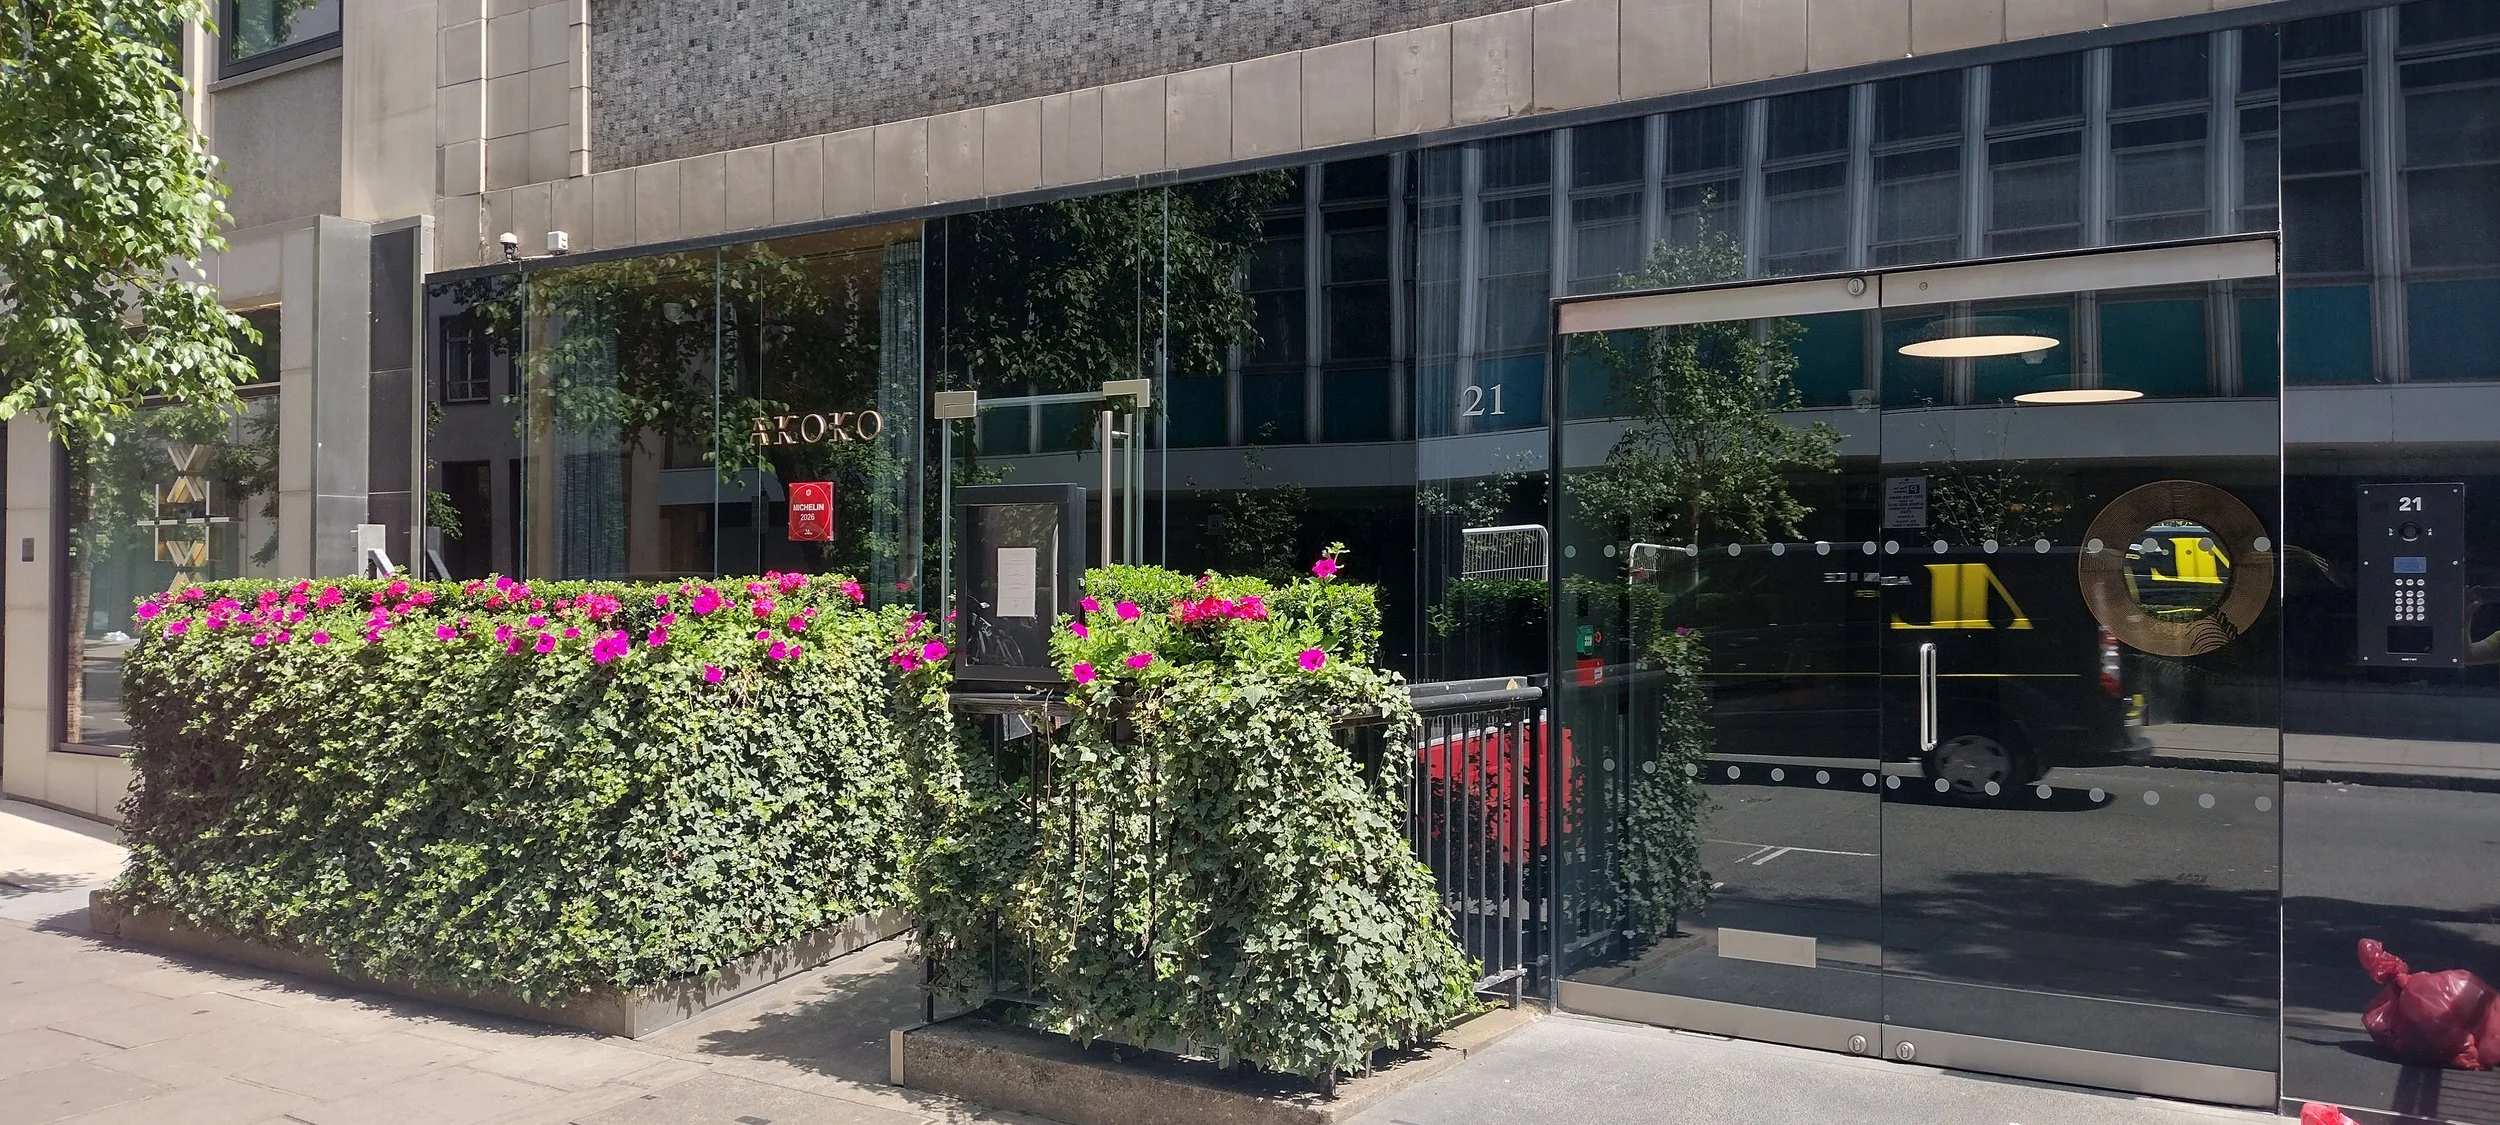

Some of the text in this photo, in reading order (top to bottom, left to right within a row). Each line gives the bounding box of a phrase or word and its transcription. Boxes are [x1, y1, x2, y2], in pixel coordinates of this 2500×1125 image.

[1462, 383, 1506, 417] 21
[750, 410, 883, 446] AKOKO
[792, 503, 825, 511] MICHELIN
[2399, 496, 2422, 511] 21
[800, 513, 815, 521] 2026
